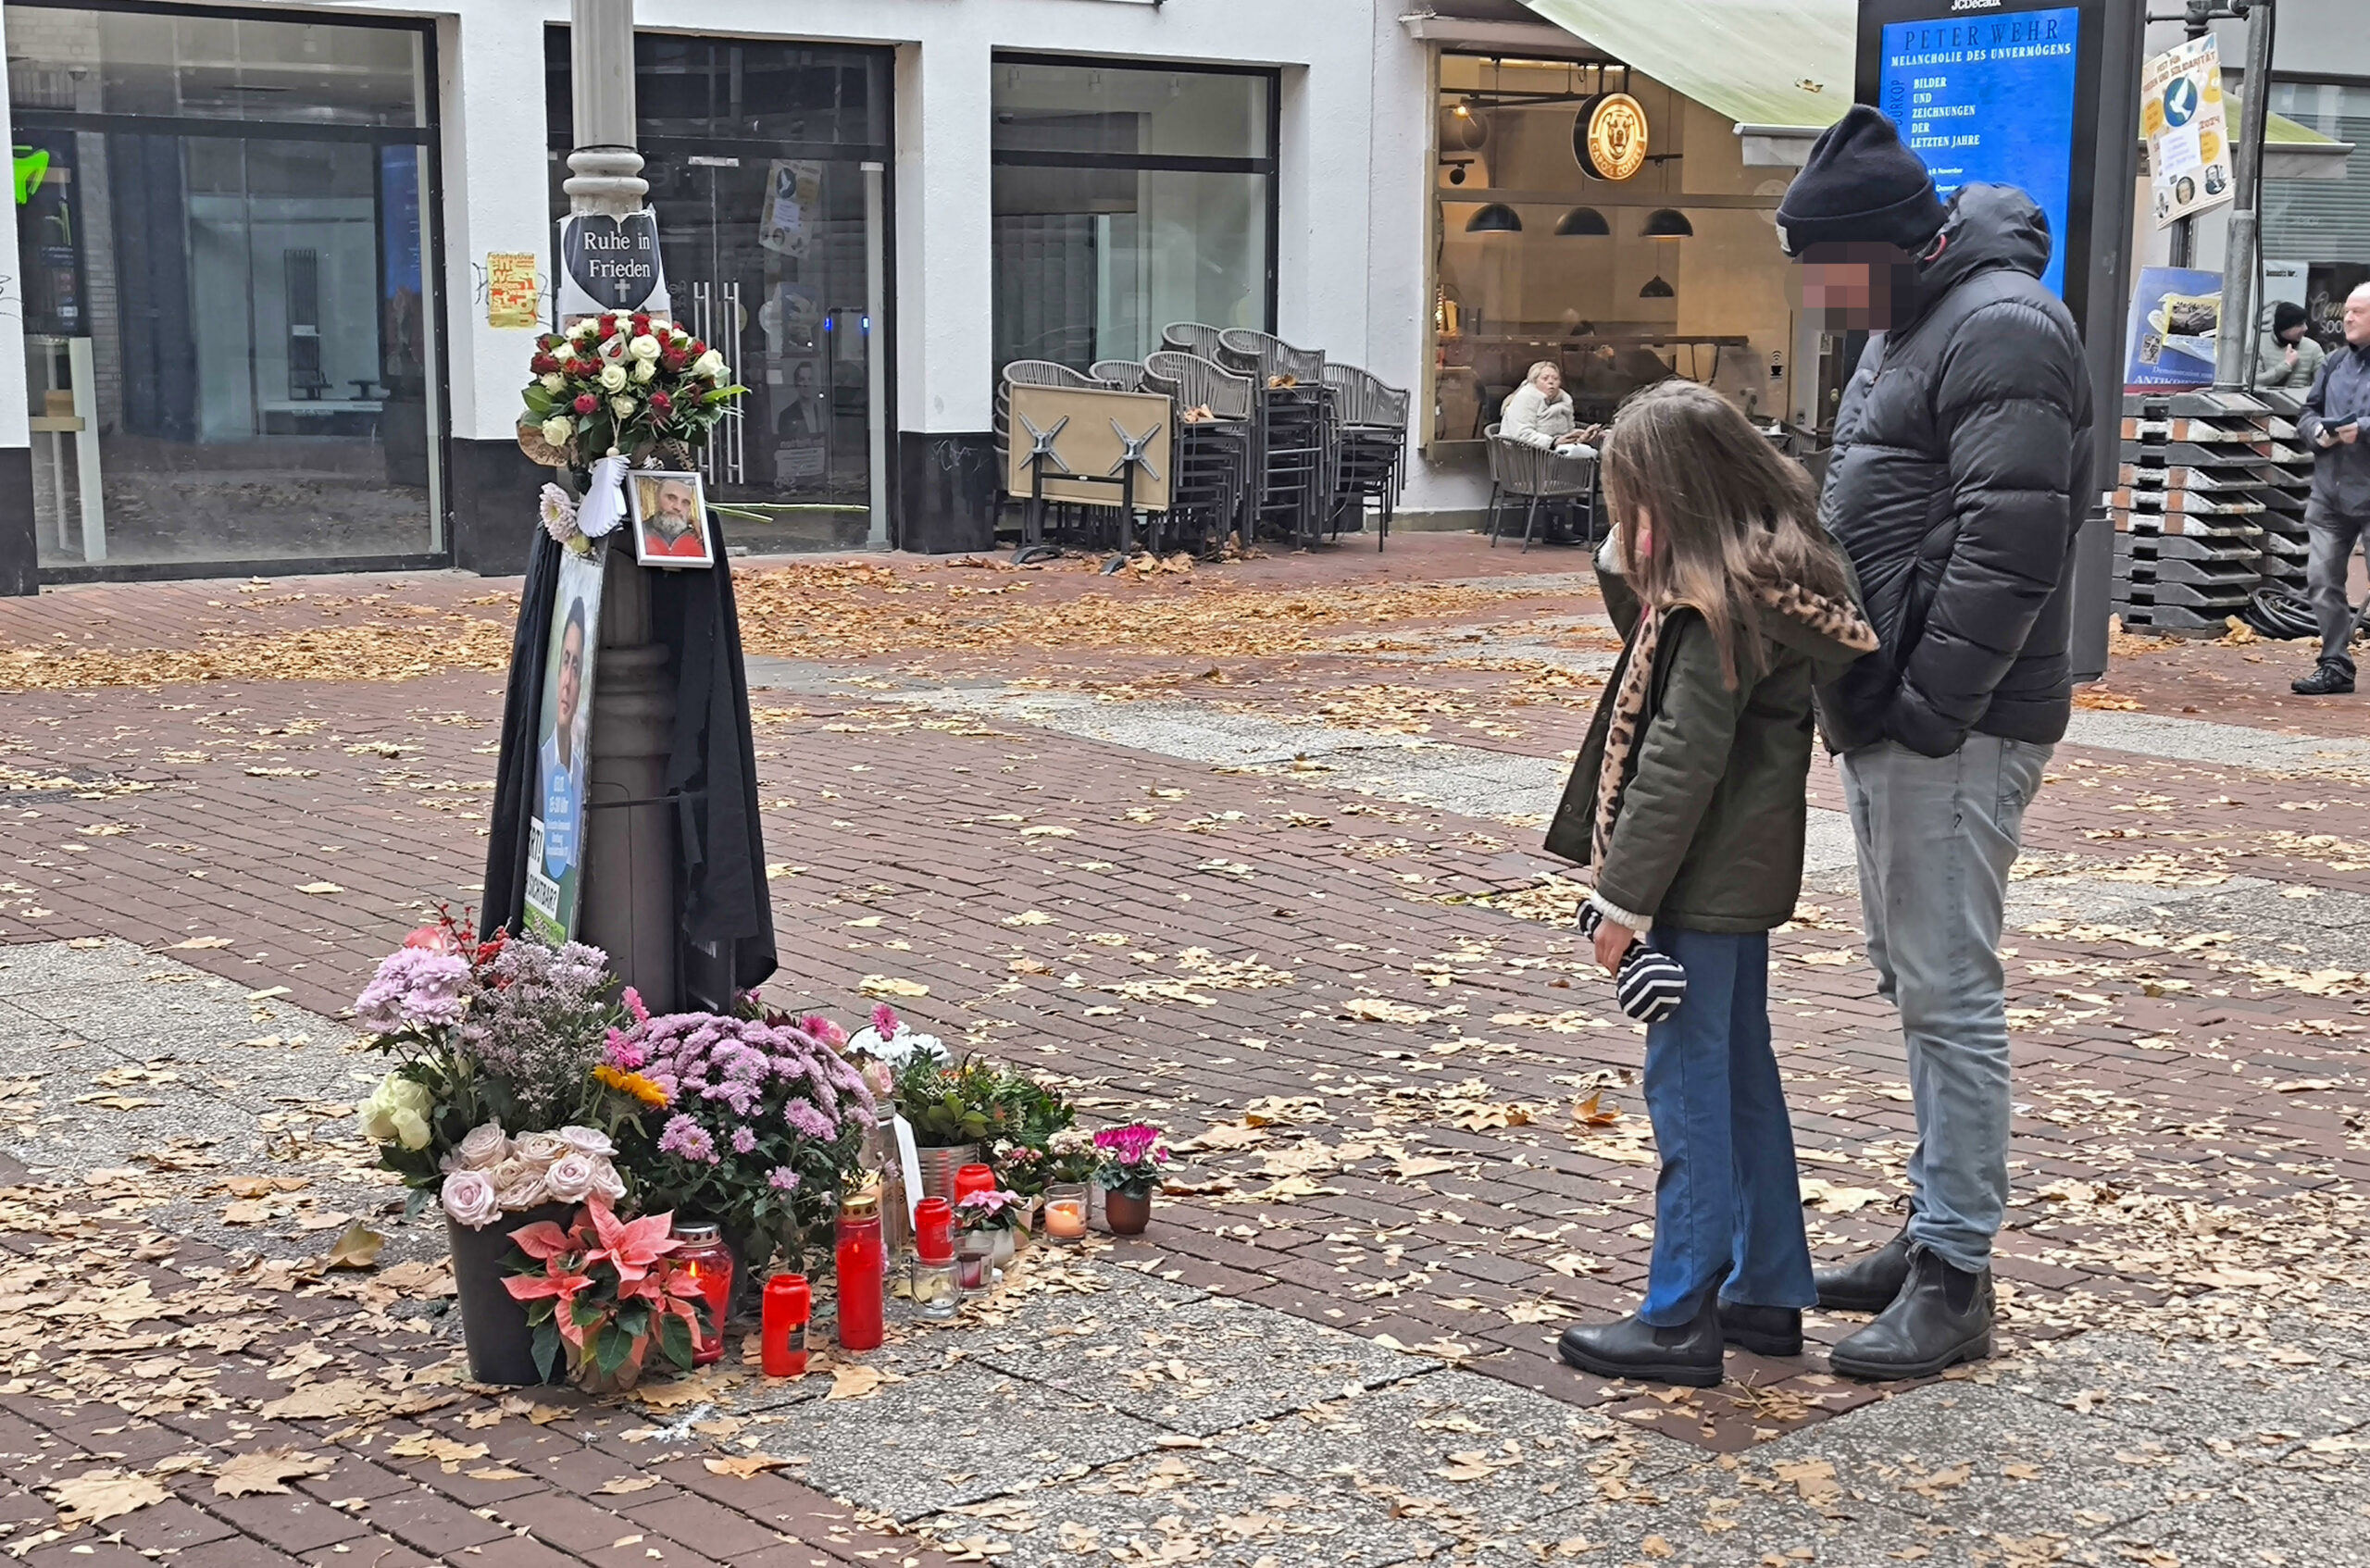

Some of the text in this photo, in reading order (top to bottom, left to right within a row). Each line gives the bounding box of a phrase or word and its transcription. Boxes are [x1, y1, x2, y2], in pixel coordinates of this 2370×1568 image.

[1904, 19, 2059, 50] PETER WEHR
[1890, 43, 2072, 67] MELANCHOLIE DES UNVERMÖGENS
[1914, 77, 1947, 90] BILDER
[1913, 93, 1932, 104] UND
[1912, 105, 1976, 119] ZEICHNUNGEN
[1911, 122, 1930, 134] DER
[1910, 134, 1980, 149] LETZTEN JAHRE
[1616, 146, 1643, 176] COFFEE
[583, 231, 651, 250] Ruhe in
[589, 258, 651, 278] Frieden
